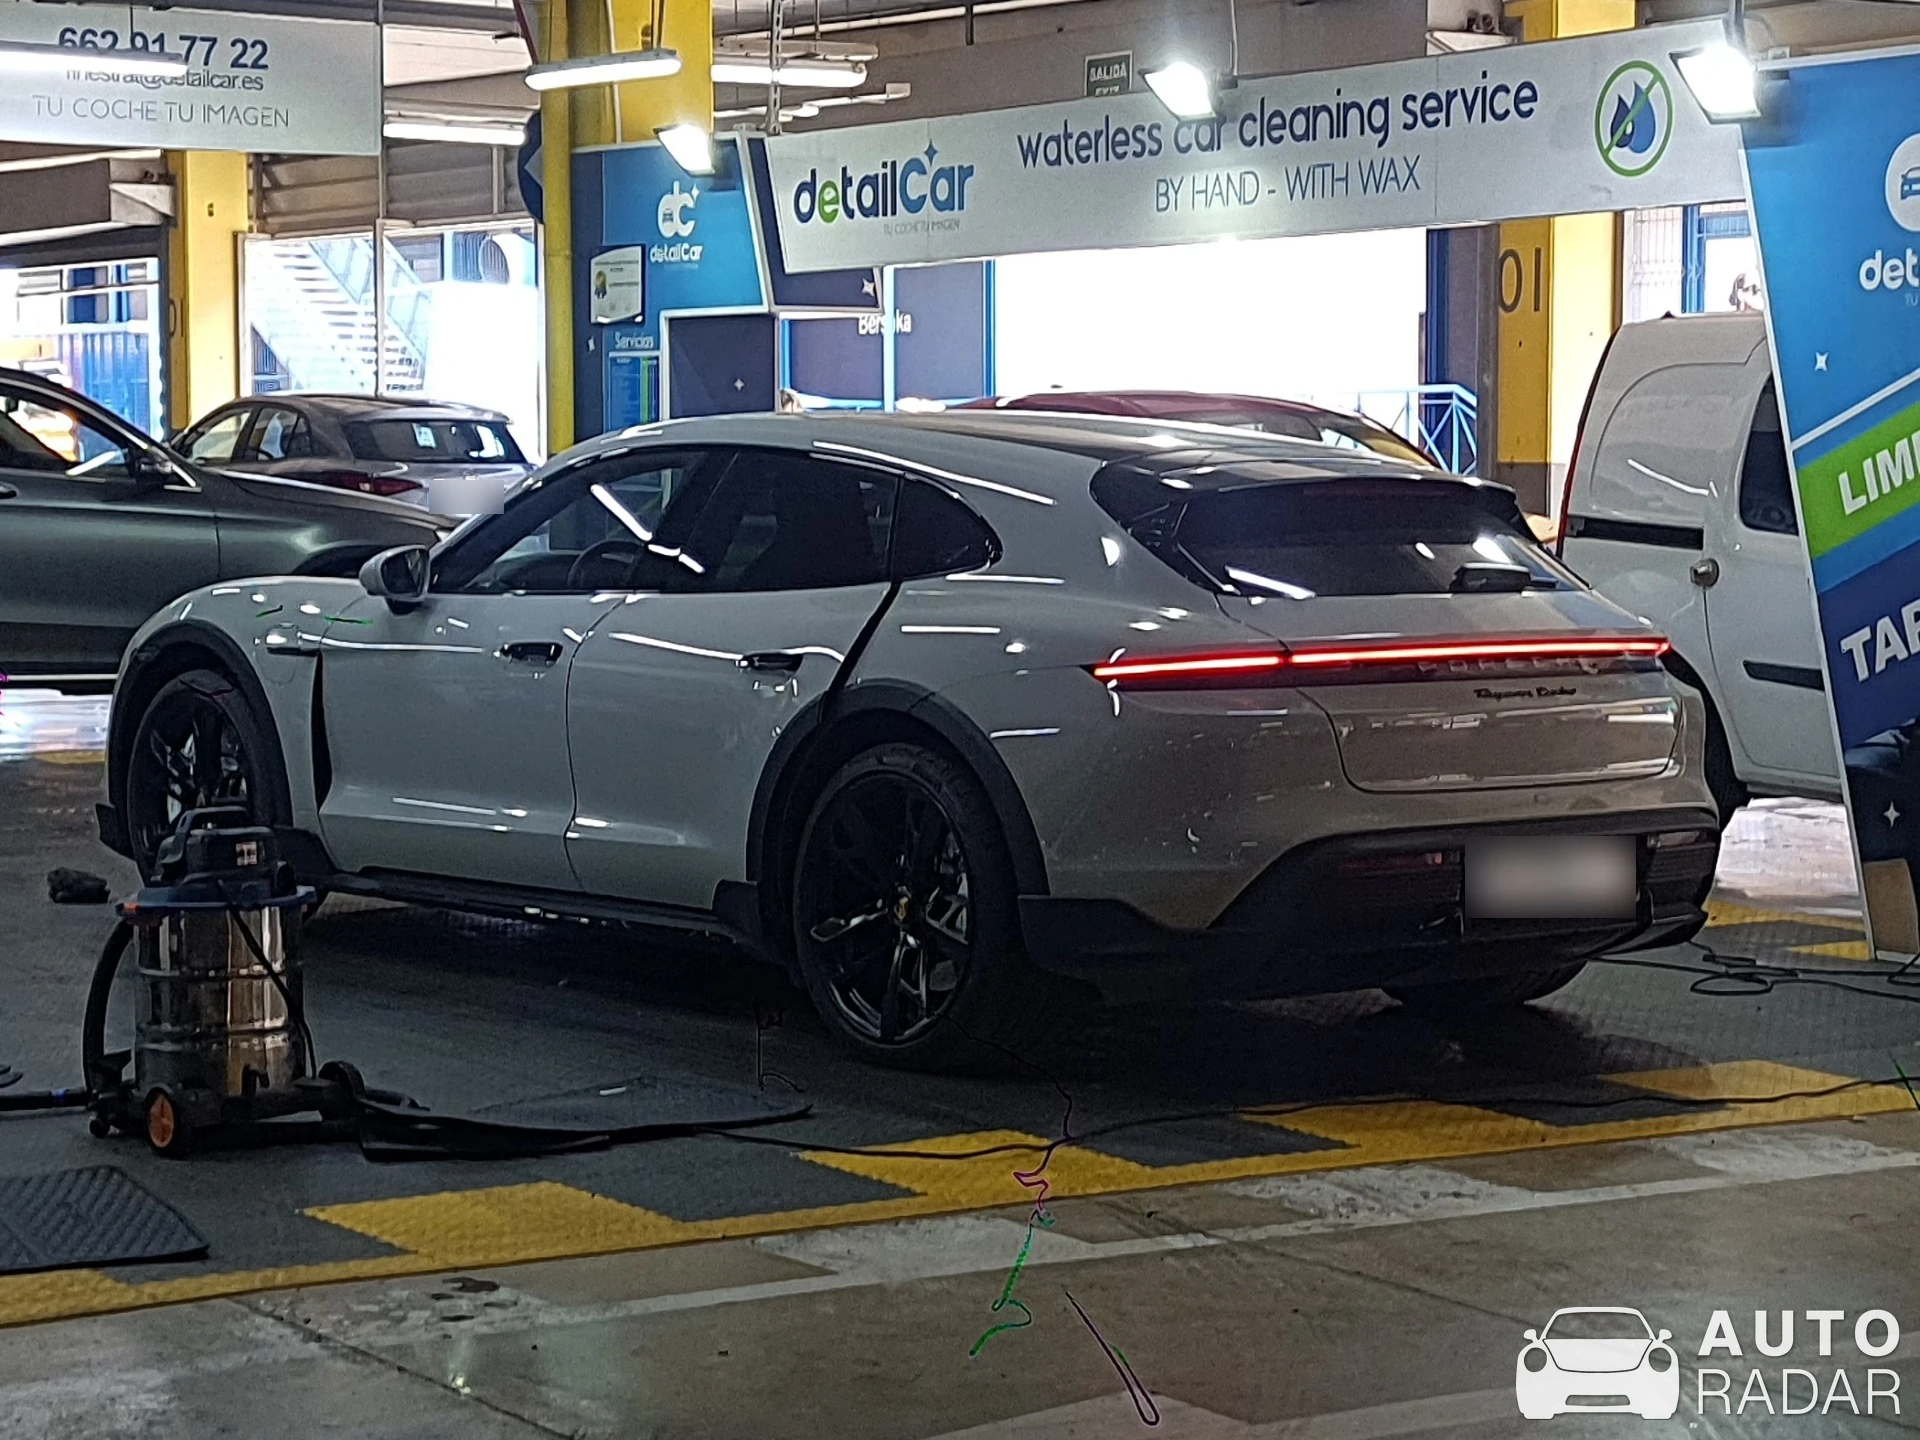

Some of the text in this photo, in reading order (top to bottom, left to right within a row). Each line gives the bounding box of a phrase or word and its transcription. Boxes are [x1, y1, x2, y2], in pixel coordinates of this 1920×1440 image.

[179, 34, 217, 66] 77
[230, 38, 269, 69] 22
[1090, 61, 1127, 82] SALIDA
[32, 95, 289, 127] TU COCHE TU IMAGEN
[1017, 70, 1538, 169] waterless car cleaning service
[793, 157, 975, 223] detailCar
[1156, 176, 1184, 212] BY
[1192, 171, 1260, 210] HAND
[1284, 161, 1349, 201] WITH
[1358, 154, 1421, 195] WAX
